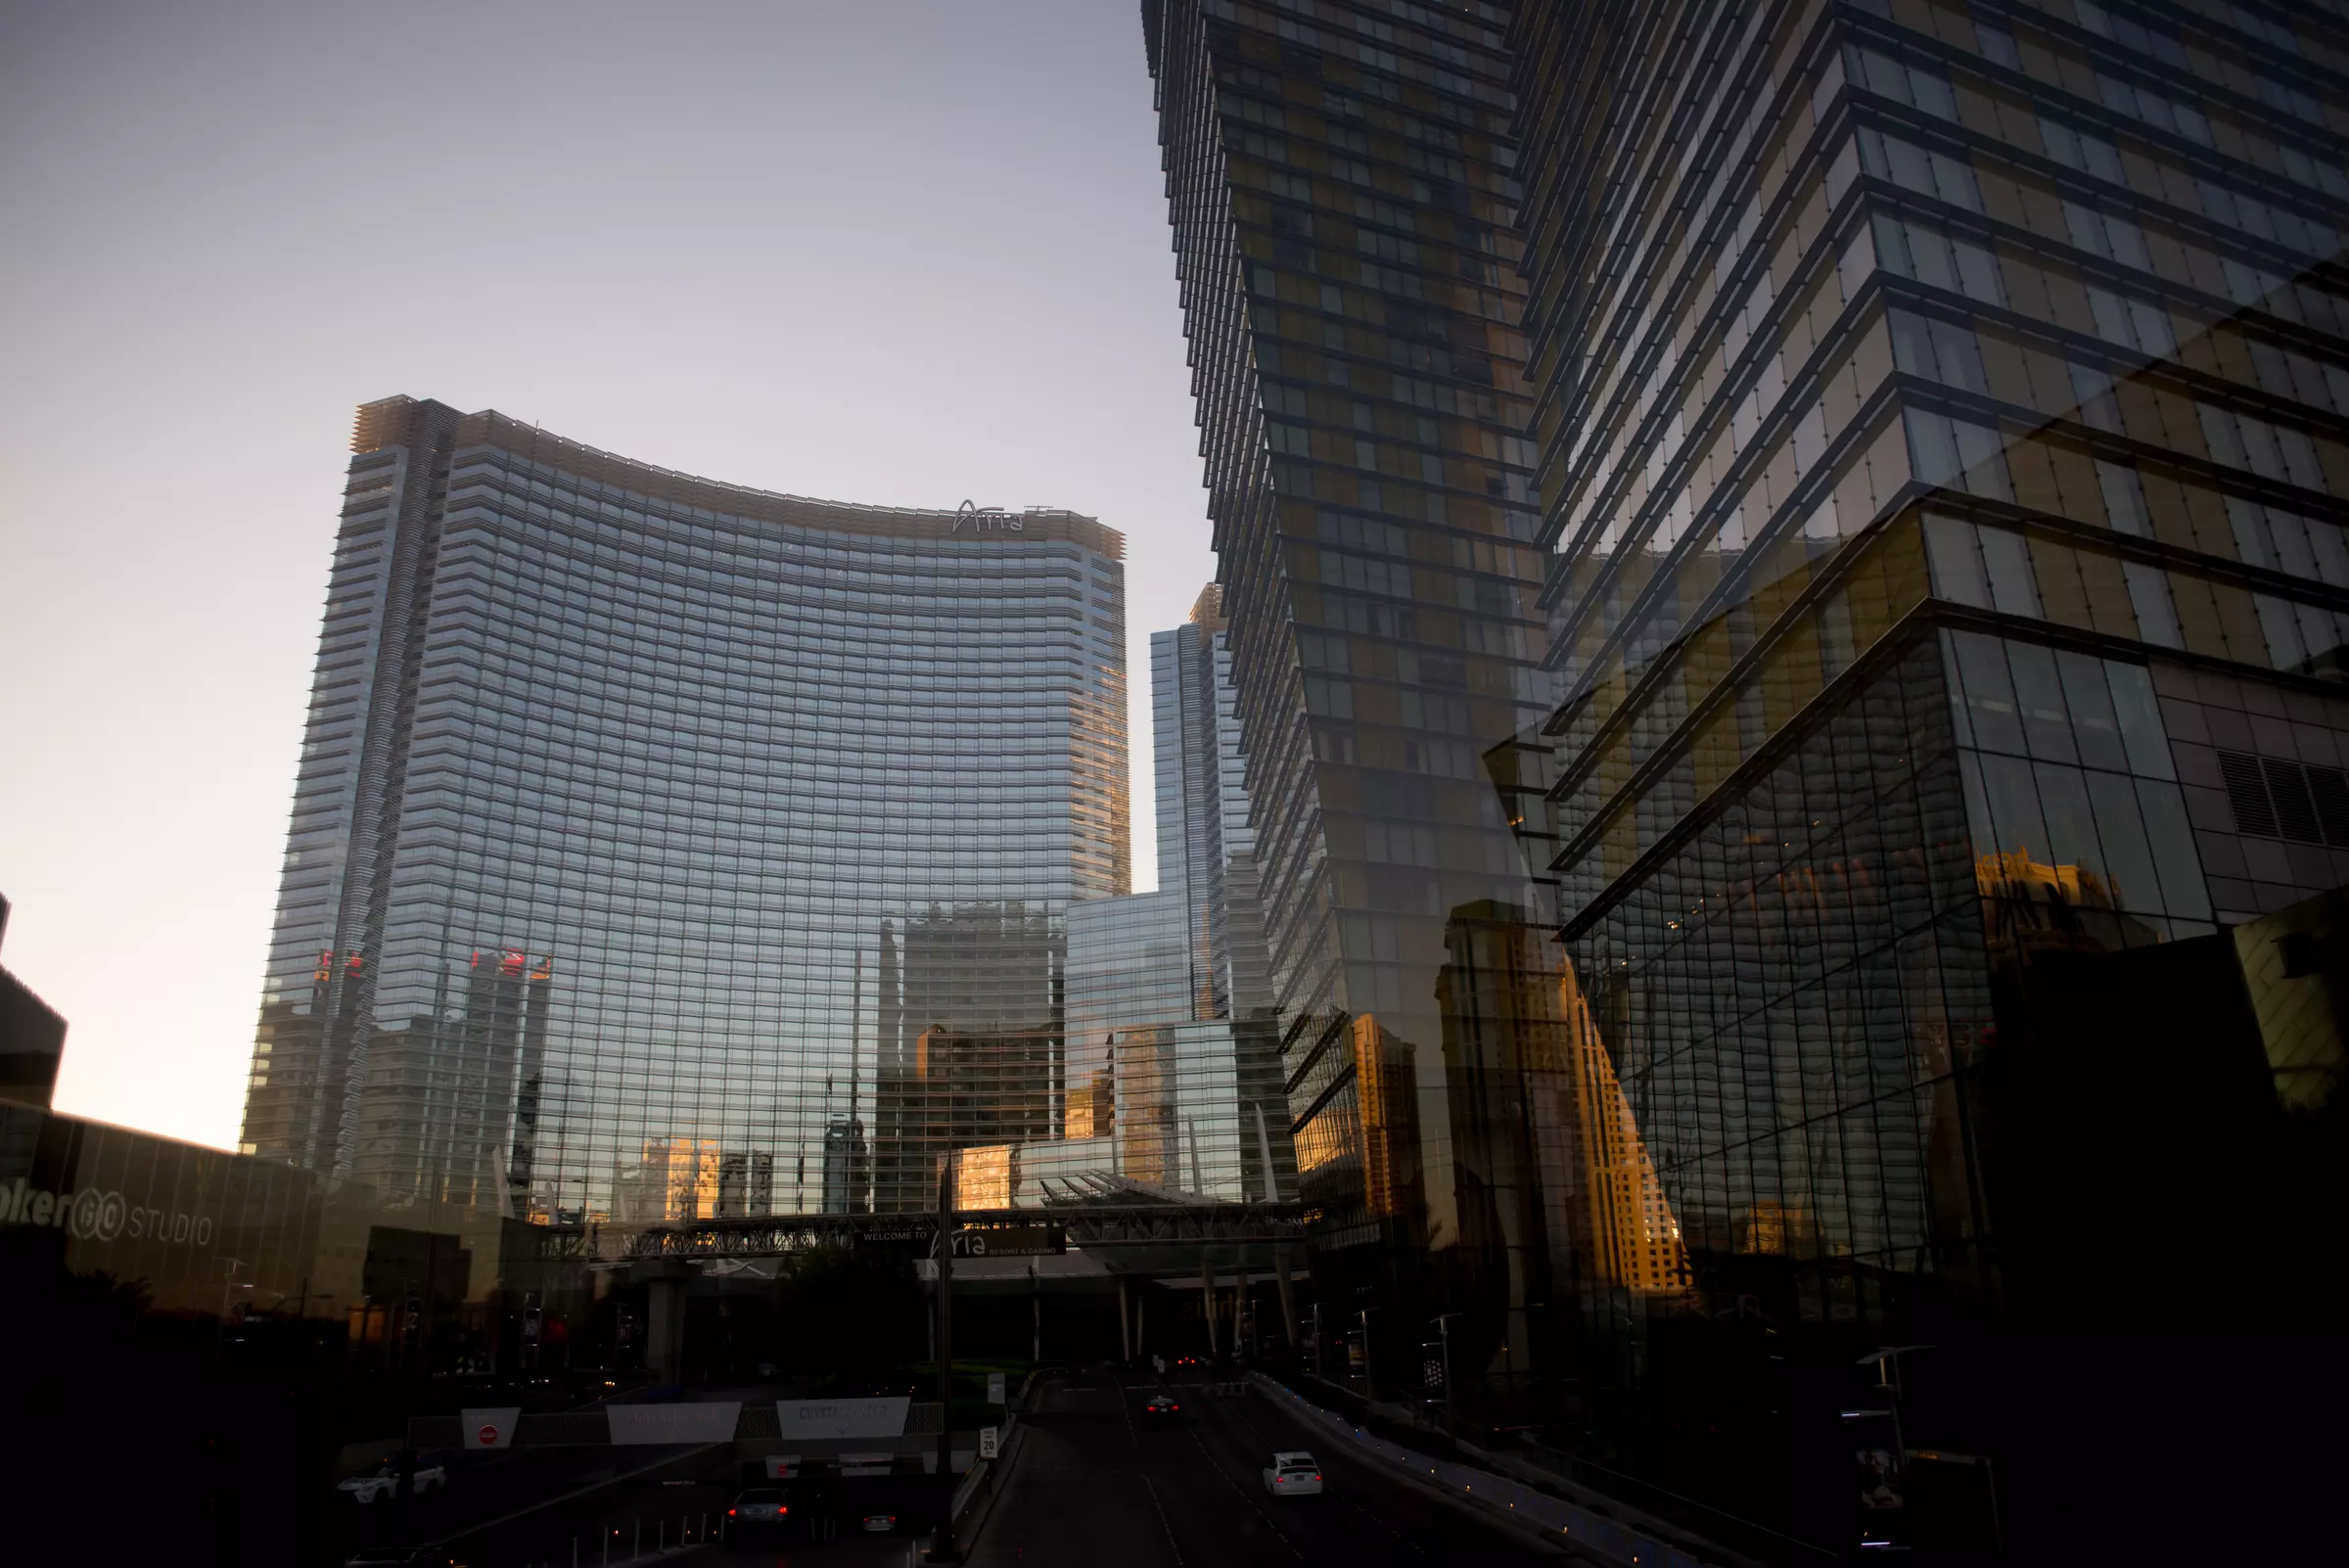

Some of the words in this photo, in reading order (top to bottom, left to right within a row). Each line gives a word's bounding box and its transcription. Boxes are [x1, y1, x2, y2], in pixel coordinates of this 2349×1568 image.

[952, 499, 1024, 533] Aria
[129, 1207, 211, 1246] STUDIO
[863, 1231, 912, 1241] WELCOME
[914, 1231, 928, 1240] TO
[984, 1440, 994, 1451] 20
